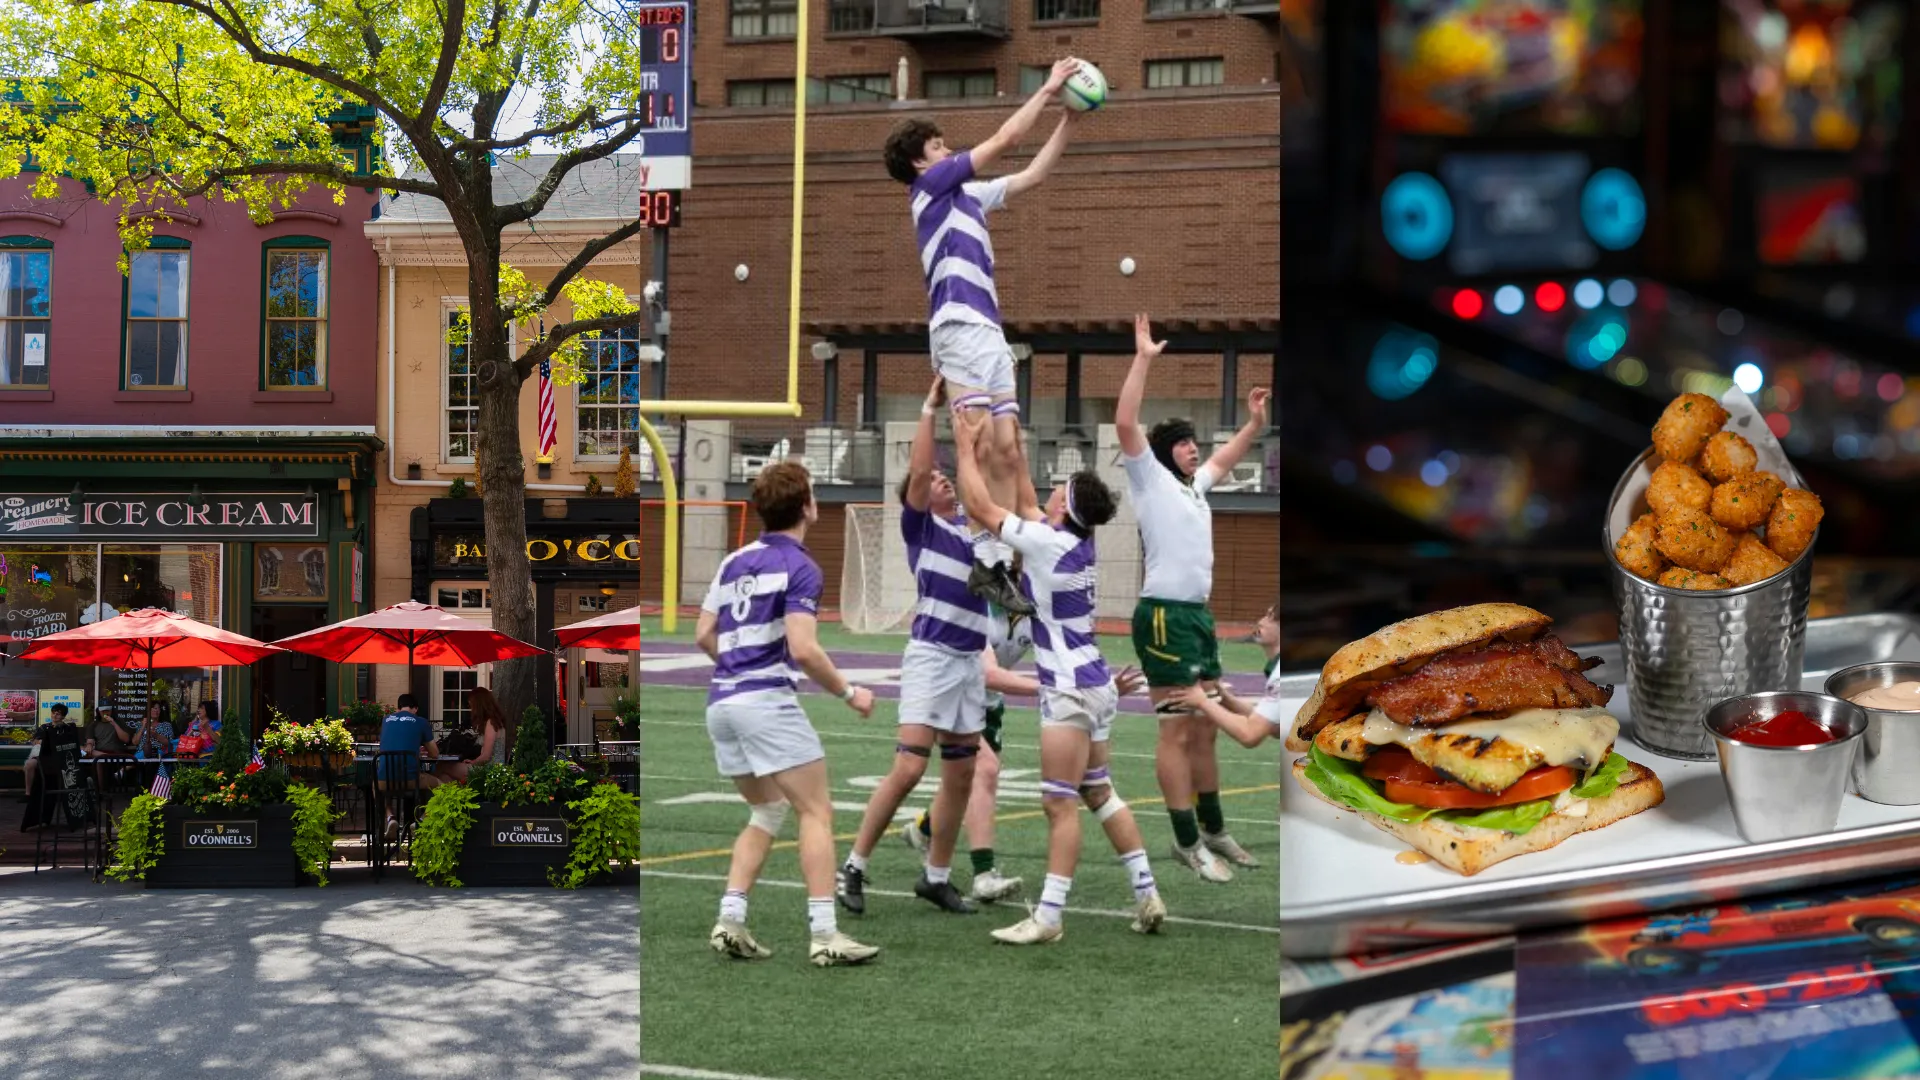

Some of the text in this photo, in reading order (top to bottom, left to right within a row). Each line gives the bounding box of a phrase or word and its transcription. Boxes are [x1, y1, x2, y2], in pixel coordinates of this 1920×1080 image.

[662, 28, 678, 61] 0
[640, 71, 659, 90] TR
[0, 497, 71, 520] reamery
[80, 501, 315, 527] ICE CREAM
[18, 516, 64, 529] HOMEMADE
[455, 544, 488, 558] BA
[33, 612, 67, 626] FROZEN
[11, 622, 67, 640] CUSTARD
[189, 834, 252, 845] O'CONNELL'S
[498, 832, 563, 843] O'CONNELL'S
